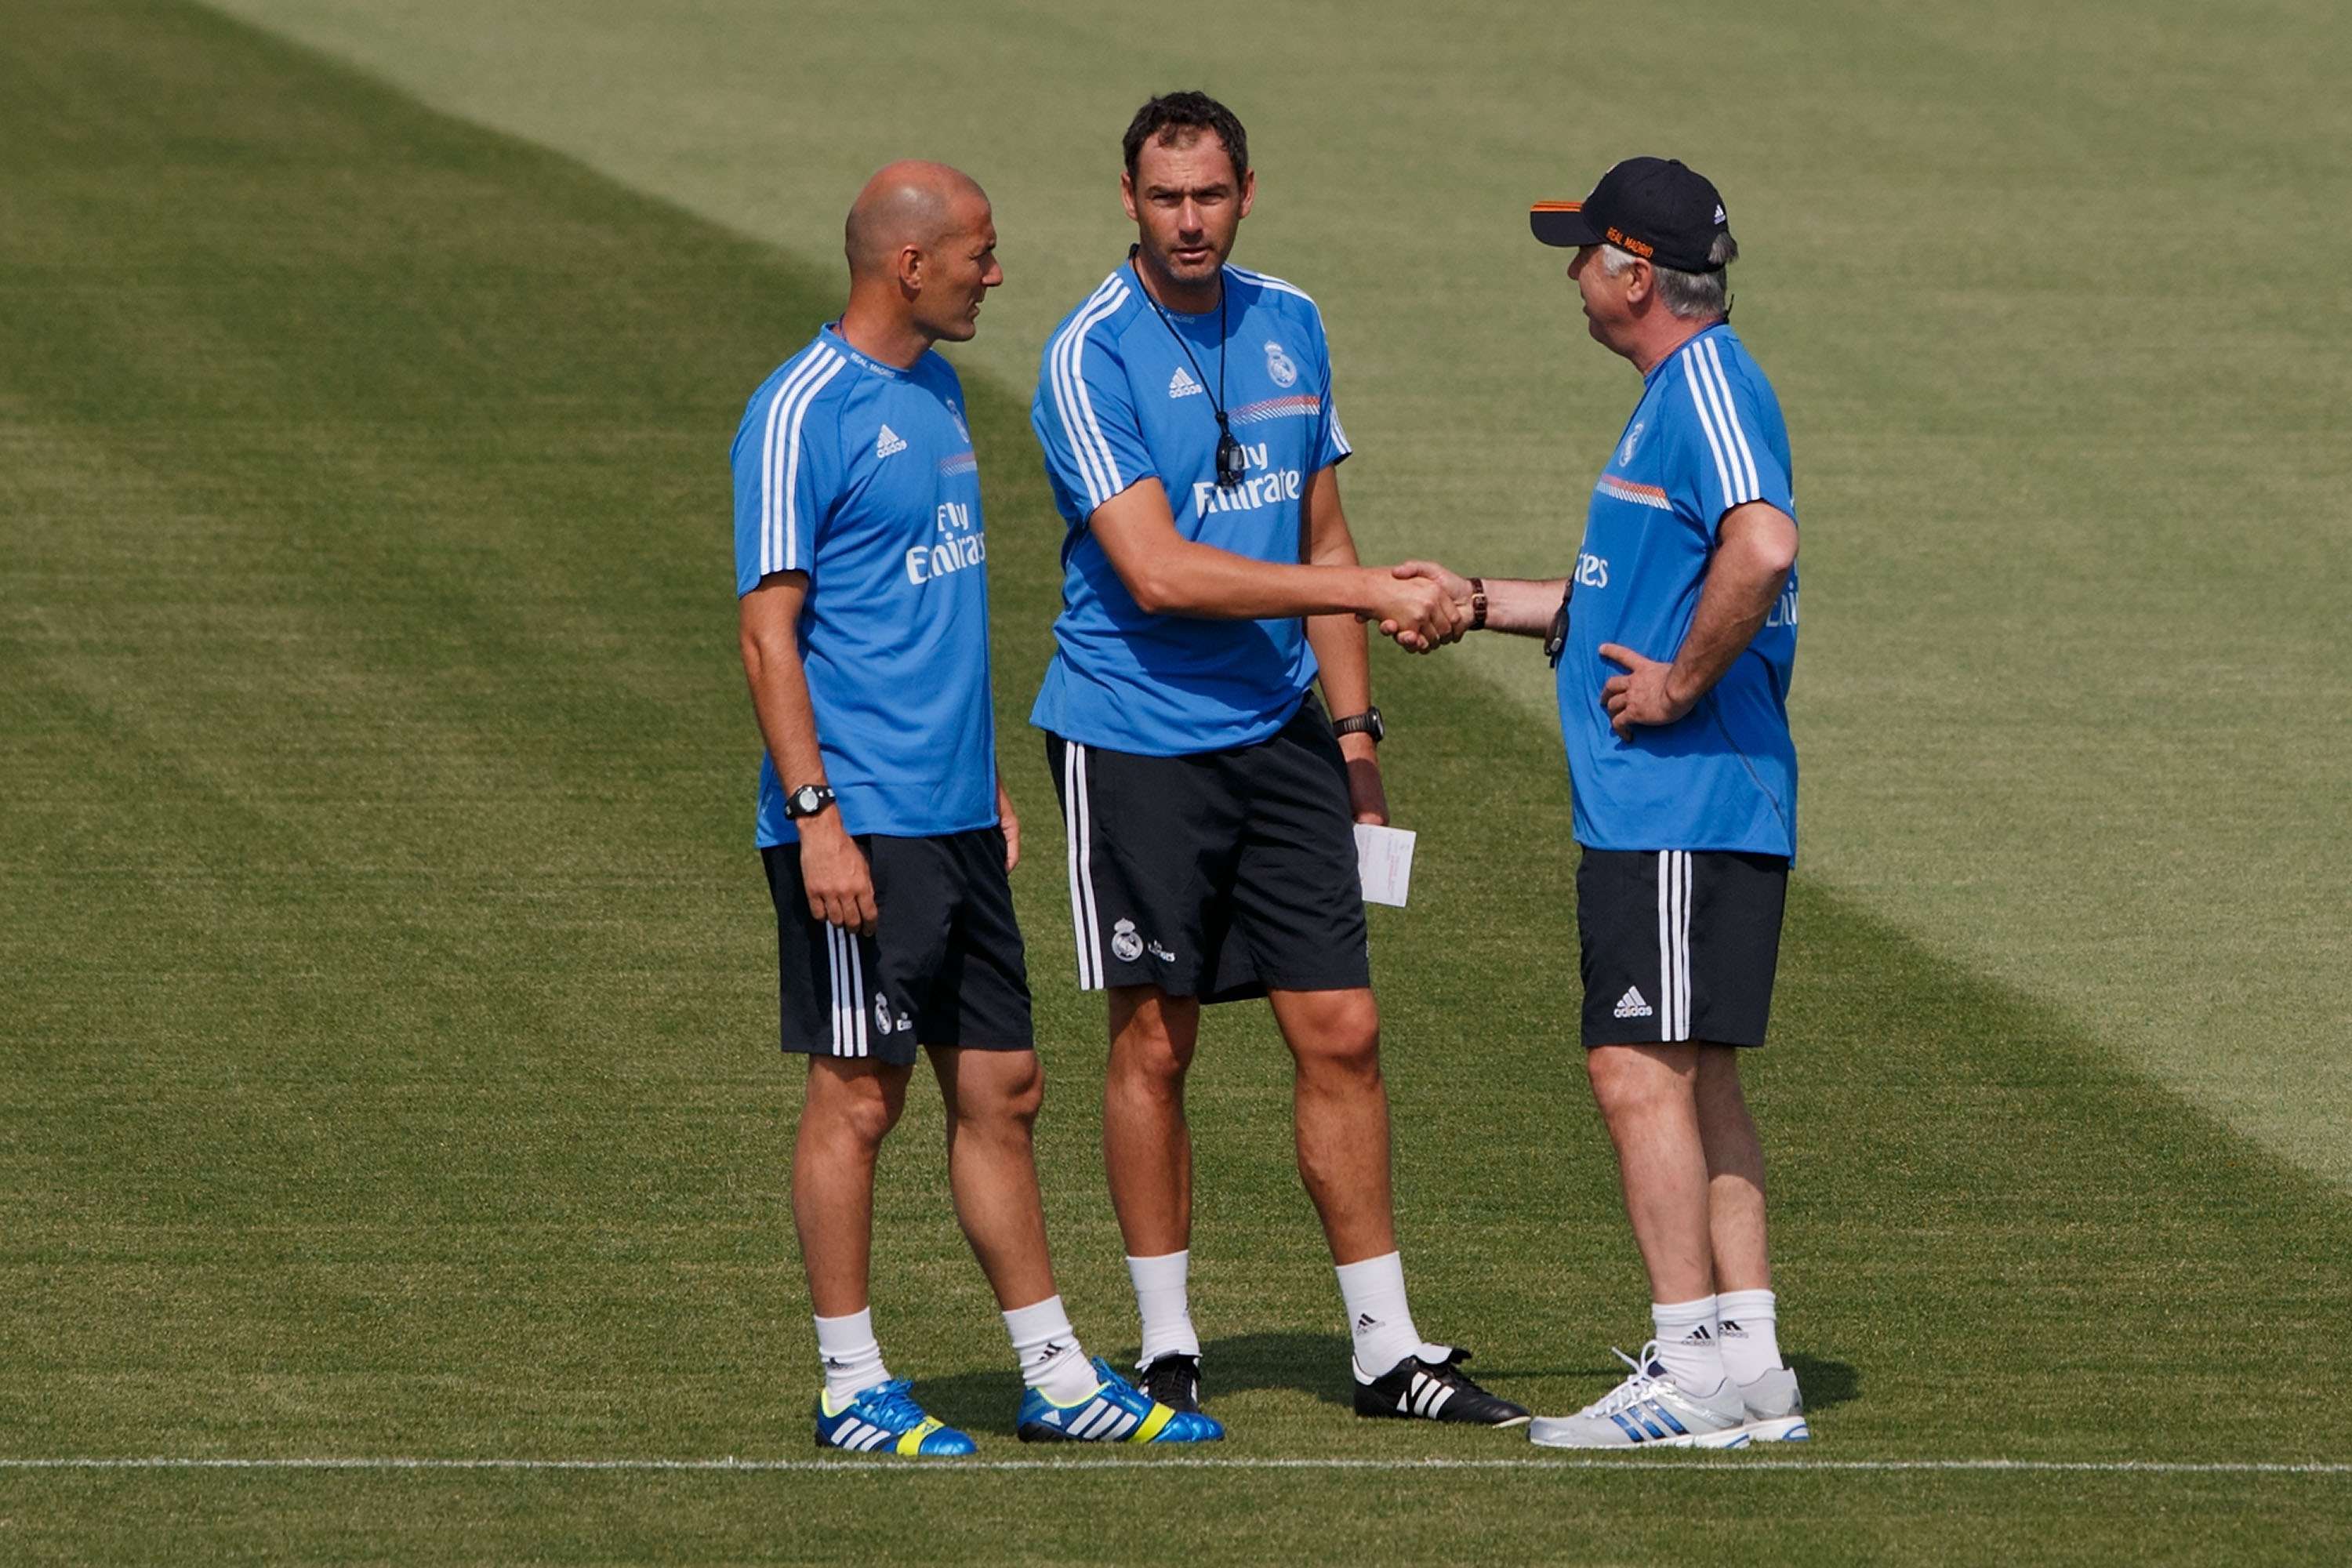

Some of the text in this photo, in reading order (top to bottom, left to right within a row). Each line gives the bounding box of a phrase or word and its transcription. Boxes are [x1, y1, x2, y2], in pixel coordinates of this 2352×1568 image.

[1624, 237, 1653, 258] MADRID
[1168, 384, 1203, 398] adidas
[877, 440, 908, 459] adidas
[1240, 442, 1269, 470] ly
[937, 502, 969, 532] Fly
[1614, 1005, 1653, 1018] adidas
